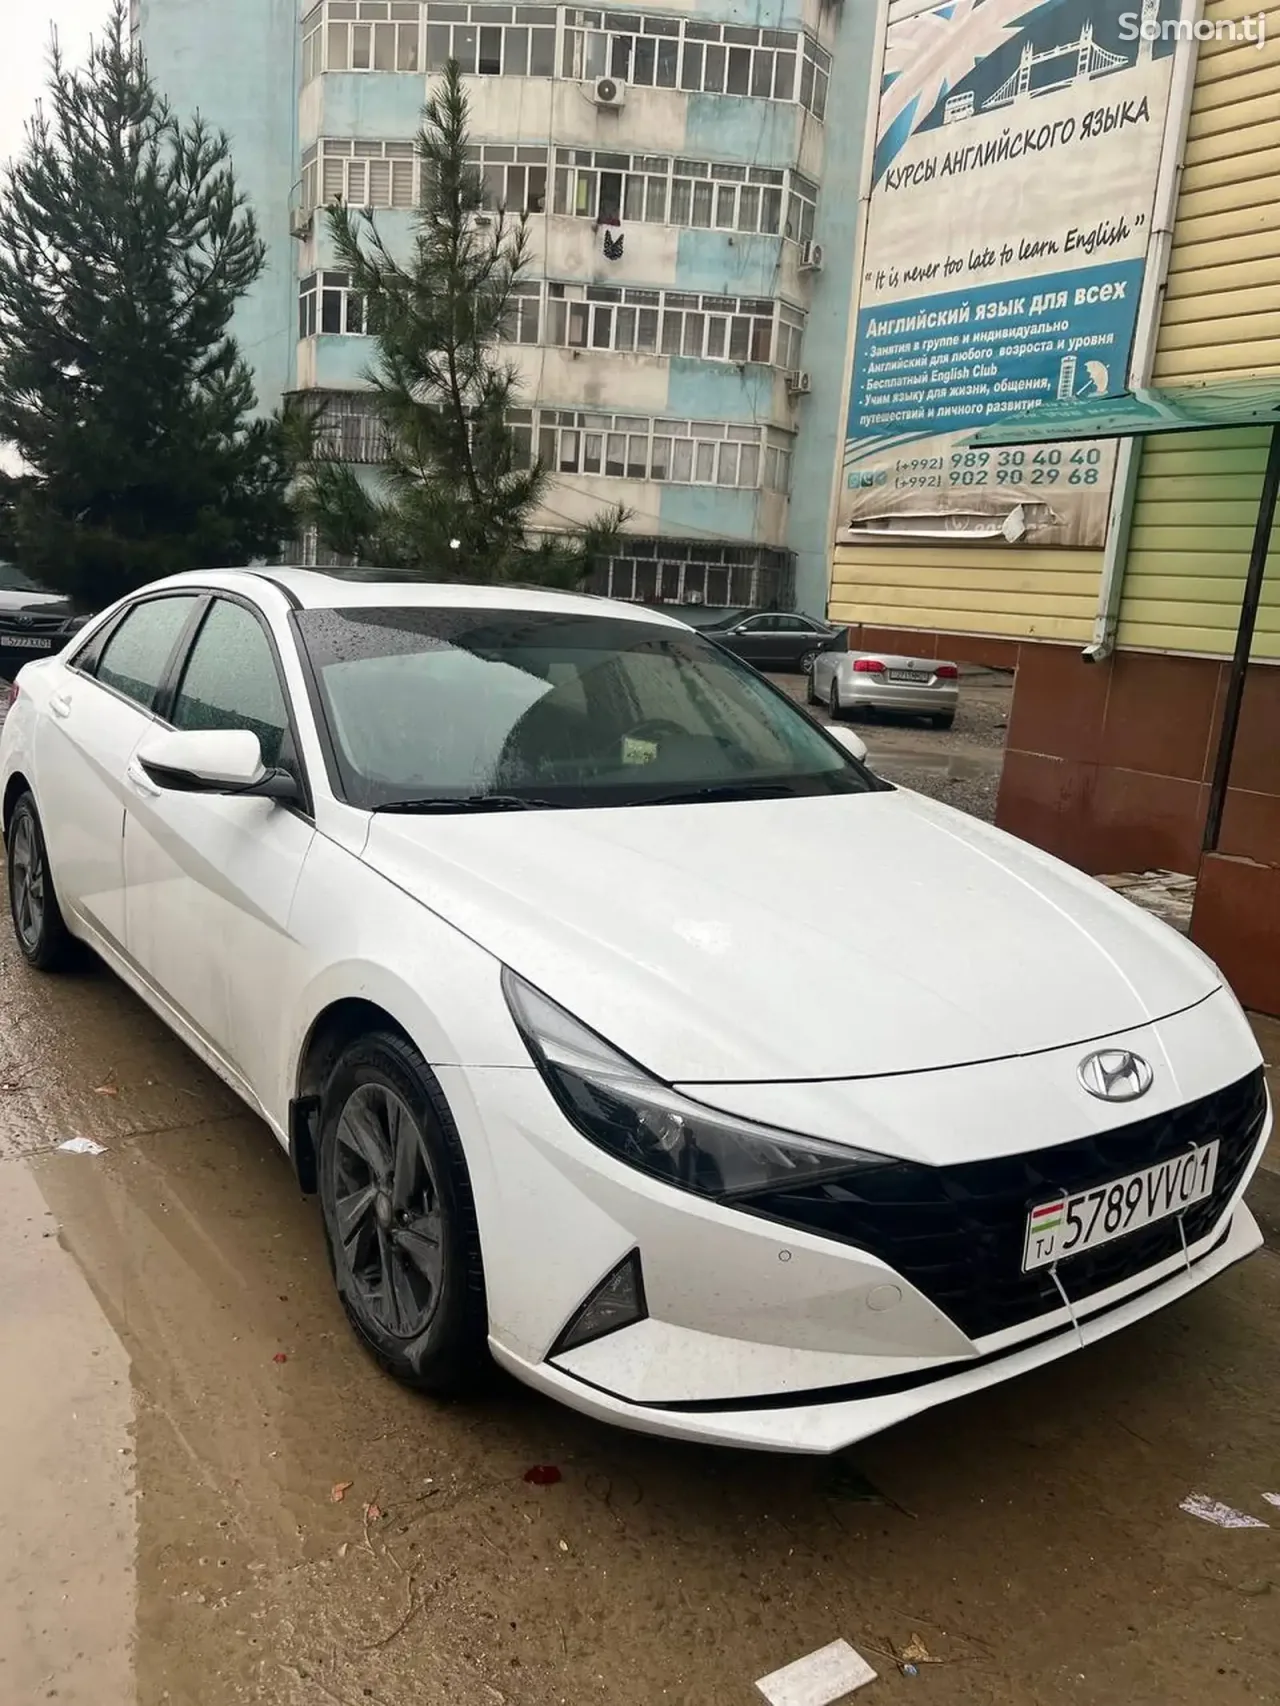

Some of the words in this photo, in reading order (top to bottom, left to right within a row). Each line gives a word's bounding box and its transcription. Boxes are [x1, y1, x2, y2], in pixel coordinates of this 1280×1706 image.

[884, 156, 938, 192] КУРСЫ
[940, 117, 1076, 176] АНГЛИЙСКОГО
[1079, 95, 1150, 141] ЯЗЫКА
[888, 266, 899, 288] is
[903, 263, 940, 282] never
[944, 255, 964, 277] too
[968, 248, 997, 270] late
[999, 243, 1013, 266] to
[1018, 238, 1059, 260] learn
[865, 300, 971, 338] Английский
[974, 296, 1026, 320] язык
[1028, 289, 1069, 317] для
[1074, 280, 1128, 306] всех
[867, 354, 928, 373] Английский
[929, 354, 949, 367] для
[951, 347, 993, 363] любого
[999, 339, 1053, 357] возроста
[1057, 339, 1065, 350] и
[1067, 332, 1115, 352] уровня
[870, 342, 911, 358] Занятия
[913, 341, 920, 351] в
[922, 333, 960, 352] группе
[962, 333, 970, 344] и
[973, 319, 1069, 344] индивидуально
[866, 371, 928, 391] Бесплатный
[931, 365, 970, 384] English
[972, 361, 998, 378] Club
[864, 393, 890, 406] Учим
[892, 389, 925, 403] языку
[926, 386, 947, 401] для
[949, 382, 990, 397] жизни,
[993, 377, 1051, 393] общения,
[859, 406, 925, 427] путешествий
[927, 406, 935, 418] и
[936, 402, 984, 418] личного
[896, 456, 944, 472] (+992)
[951, 451, 991, 468] 989
[997, 450, 1026, 467] 30
[1031, 448, 1062, 466] 40
[1069, 447, 1101, 465] 40
[894, 475, 942, 489] (+992)
[949, 470, 989, 486] 902
[996, 468, 1023, 486] 90
[1030, 468, 1060, 485] 29
[1067, 467, 1099, 485] 68
[1035, 1234, 1056, 1259] TJ
